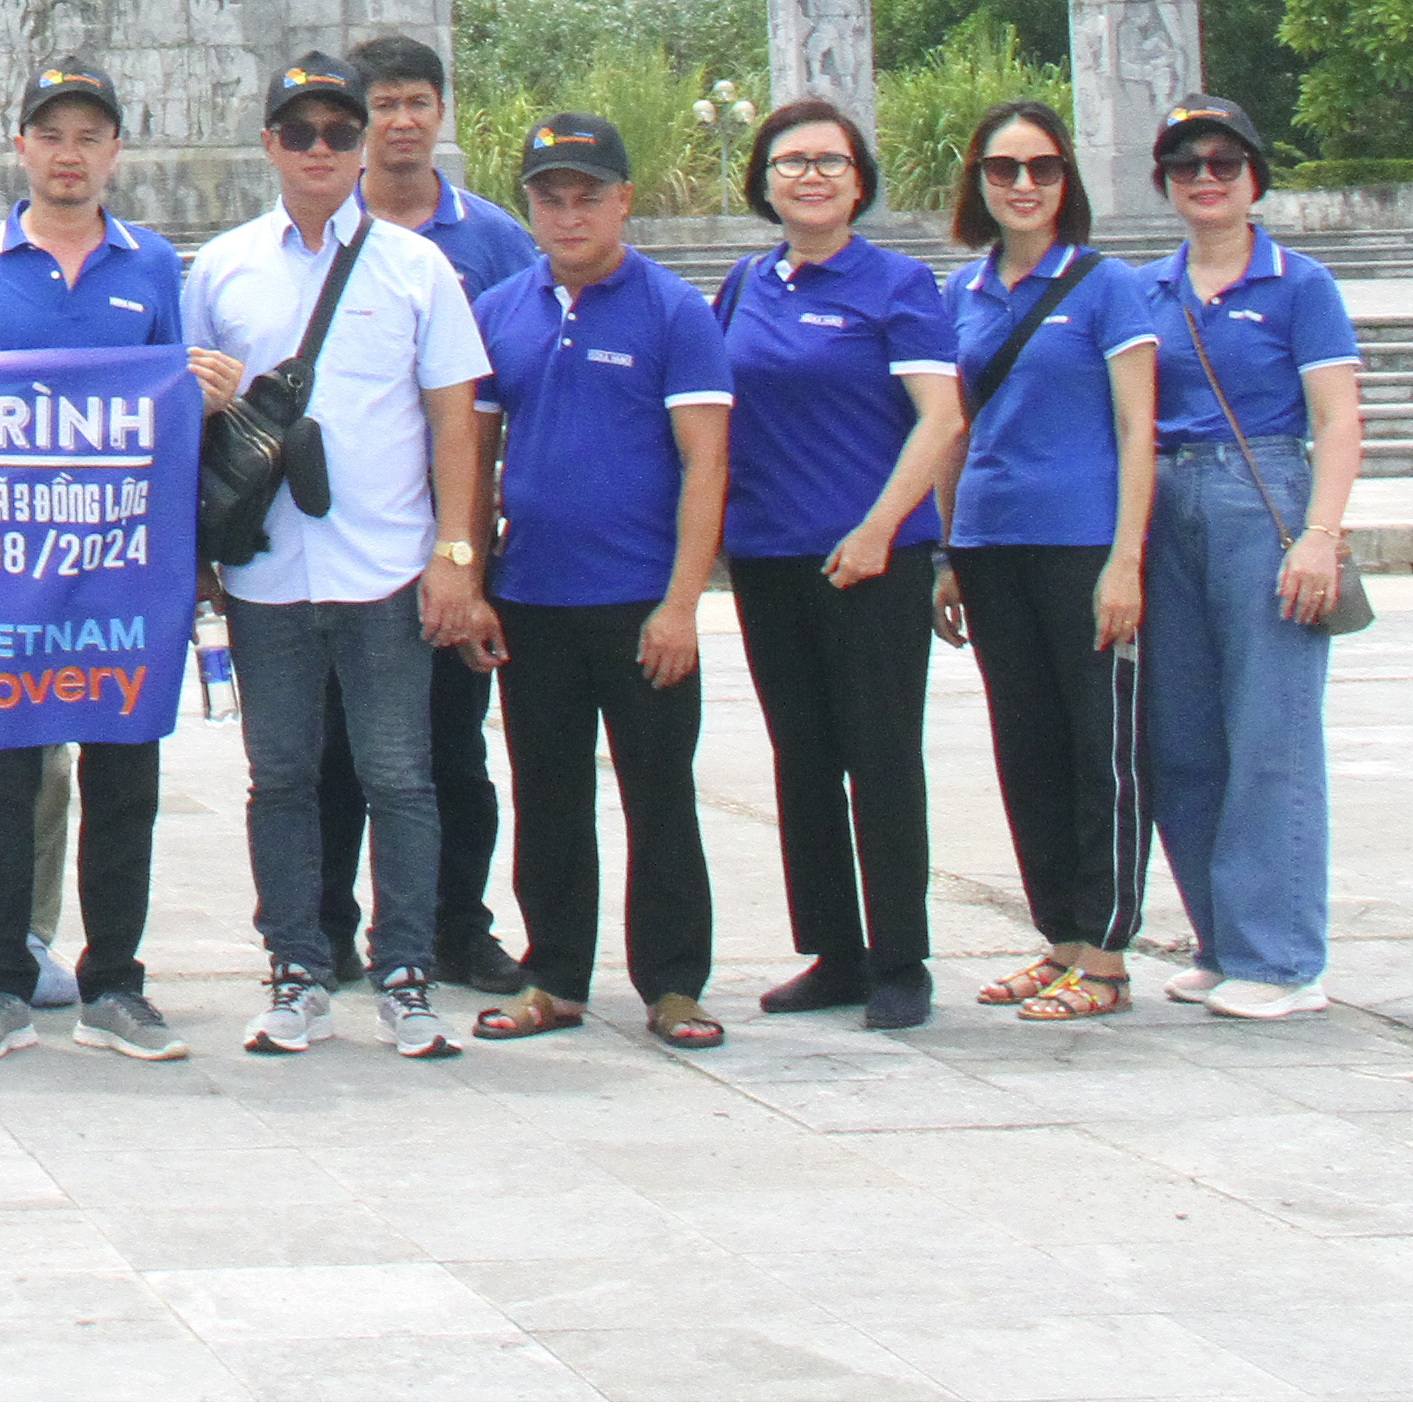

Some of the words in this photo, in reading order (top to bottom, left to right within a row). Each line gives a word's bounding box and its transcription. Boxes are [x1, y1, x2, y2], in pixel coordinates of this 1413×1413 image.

[14, 483, 30, 522] 3
[33, 471, 101, 524] ĐỒNG
[105, 476, 148, 525] LỘC
